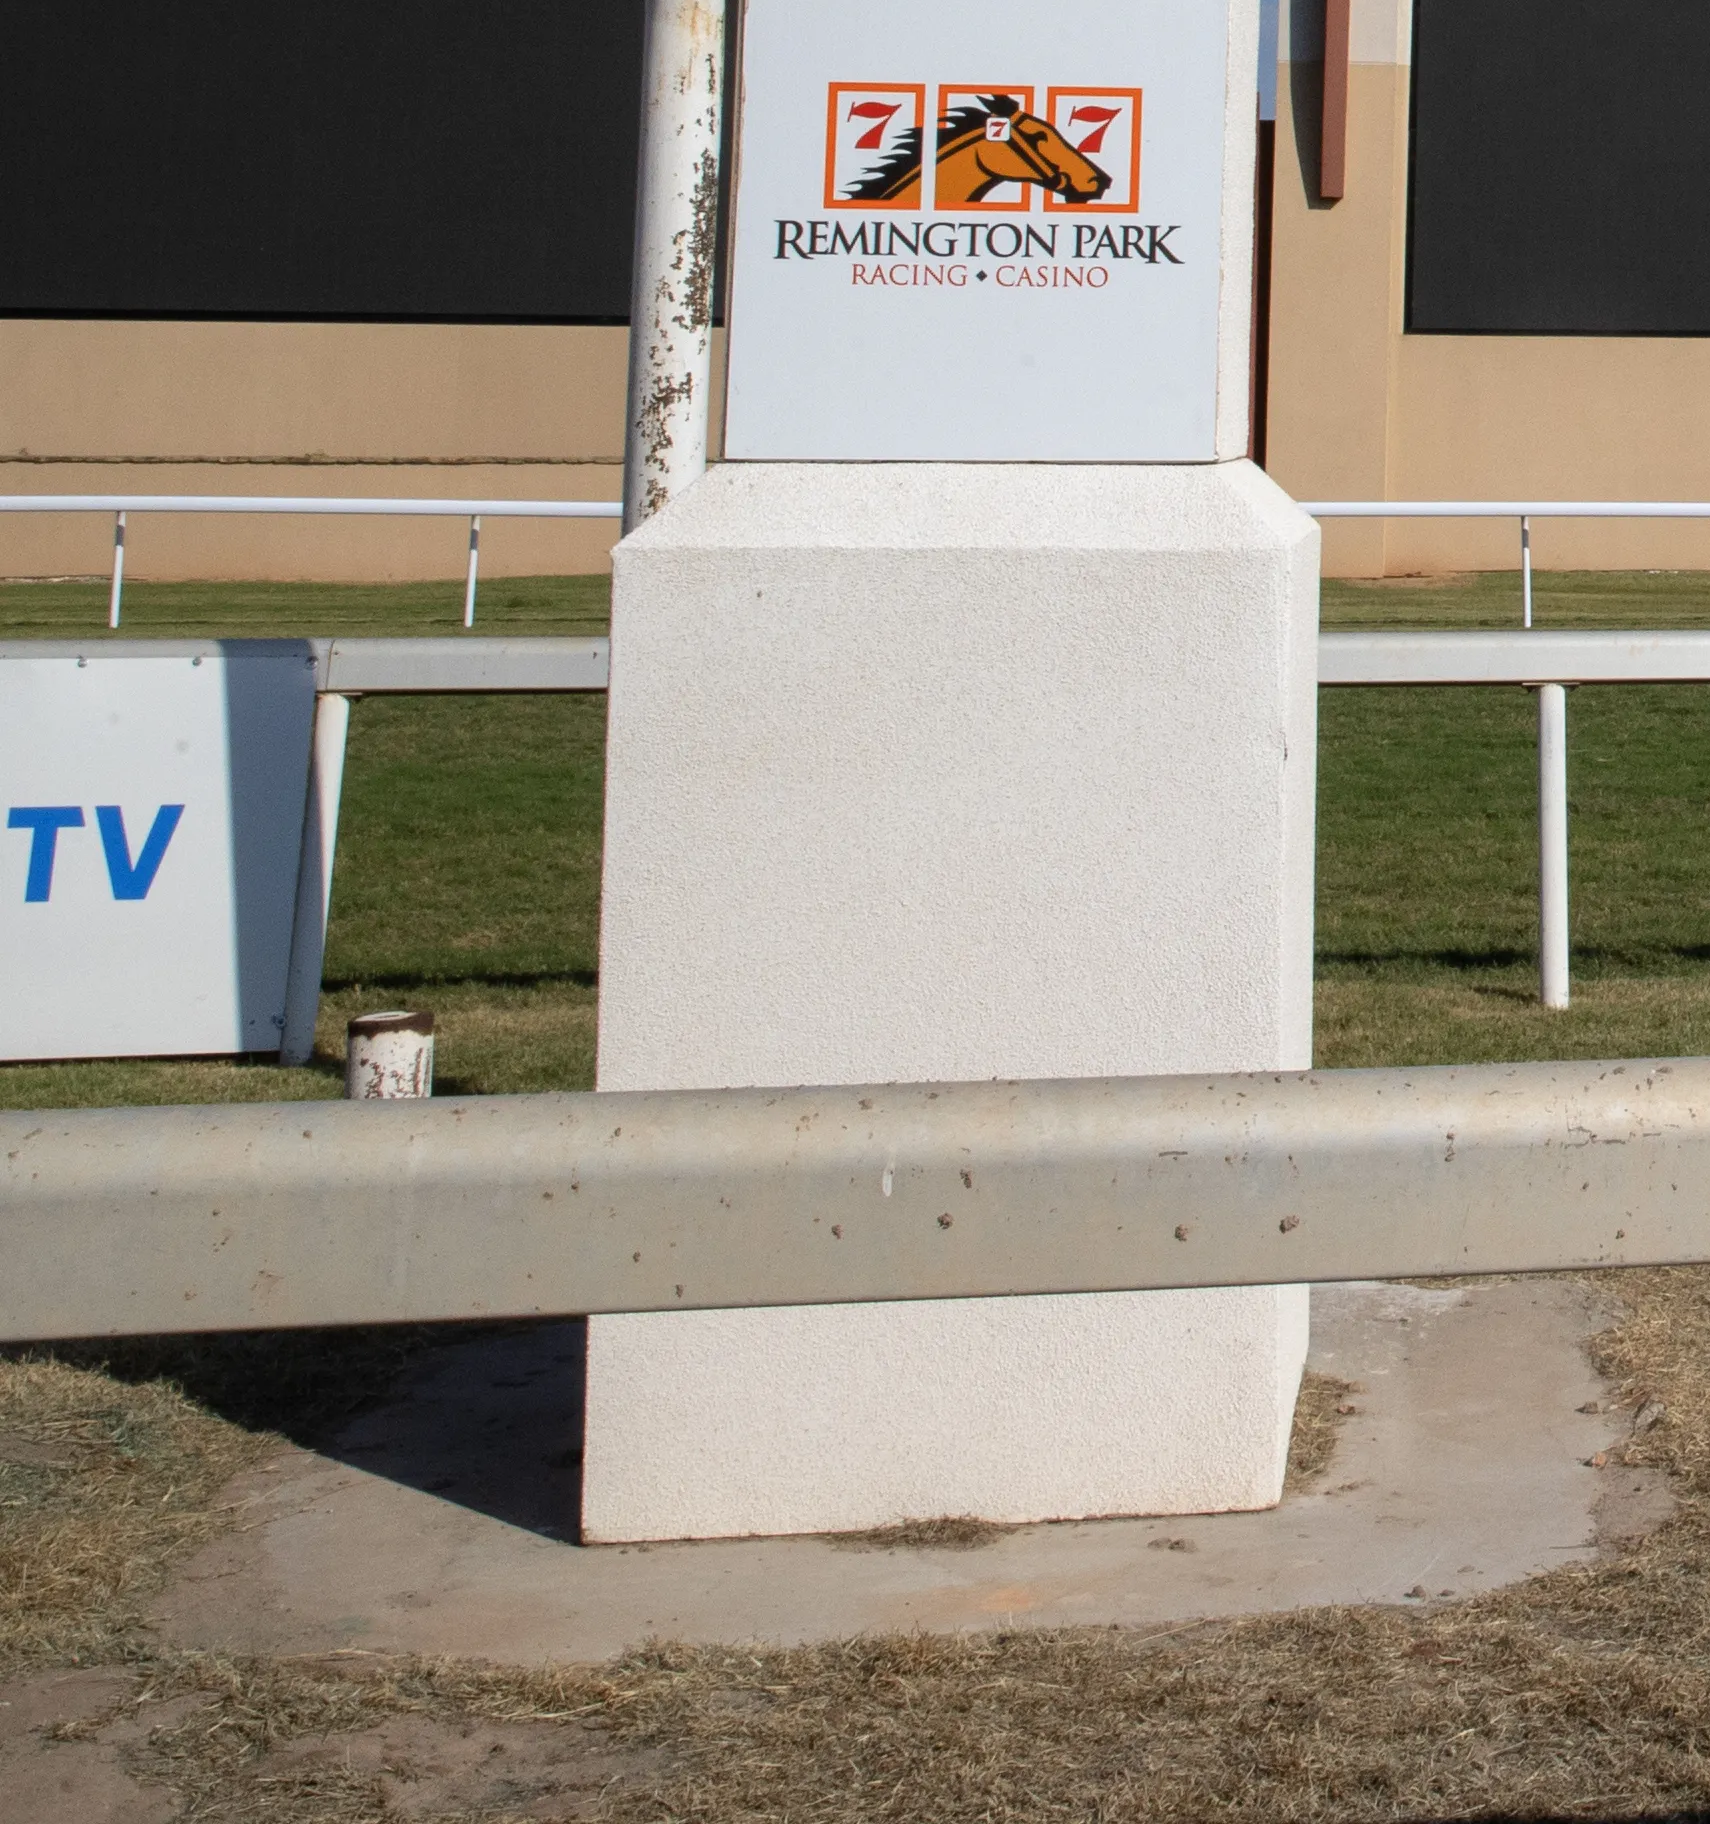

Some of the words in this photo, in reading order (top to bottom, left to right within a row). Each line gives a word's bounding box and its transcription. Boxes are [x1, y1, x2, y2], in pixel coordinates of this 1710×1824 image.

[847, 101, 902, 150] 7
[989, 121, 1008, 138] 7
[1067, 105, 1123, 154] 7
[774, 219, 1058, 261] REMINGTON
[1072, 223, 1185, 265] PARK
[851, 263, 969, 288] RACING
[995, 265, 1109, 289] CASINO
[7, 803, 186, 903] TV
